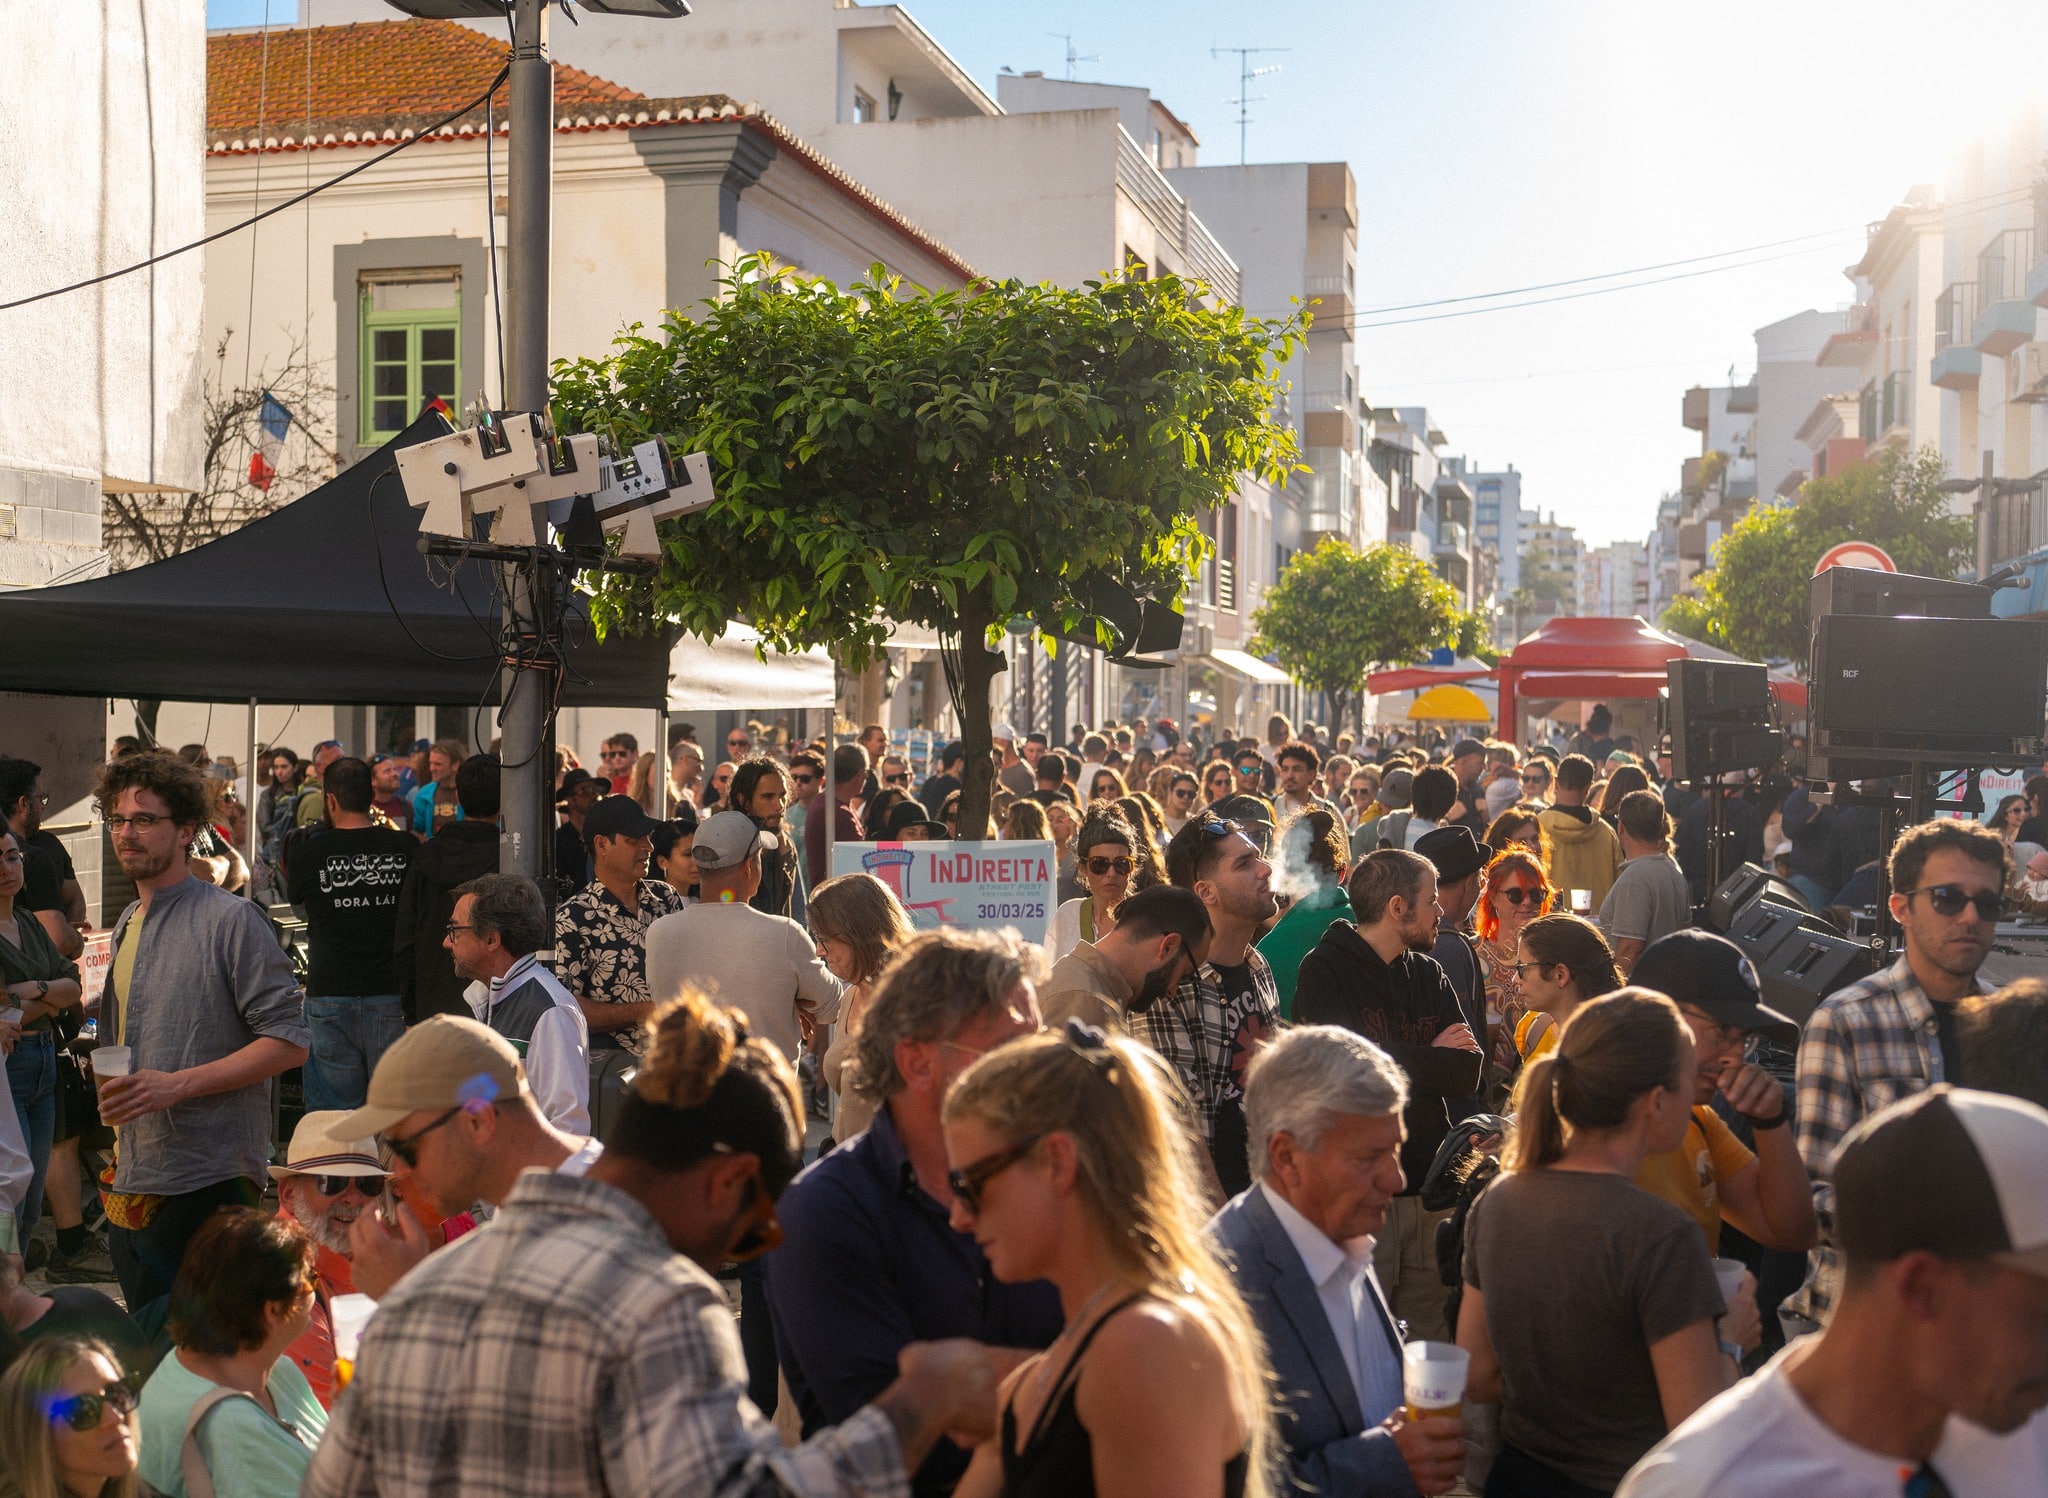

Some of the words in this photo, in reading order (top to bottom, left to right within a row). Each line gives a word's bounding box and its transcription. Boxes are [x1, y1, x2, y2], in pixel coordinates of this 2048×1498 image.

[1842, 669, 1859, 678] RCF
[1979, 775, 2022, 790] NDIREIT
[334, 897, 370, 907] BORA
[376, 895, 395, 905] LÁ!
[977, 903, 1044, 919] 30/03/25
[86, 953, 110, 967] COMP
